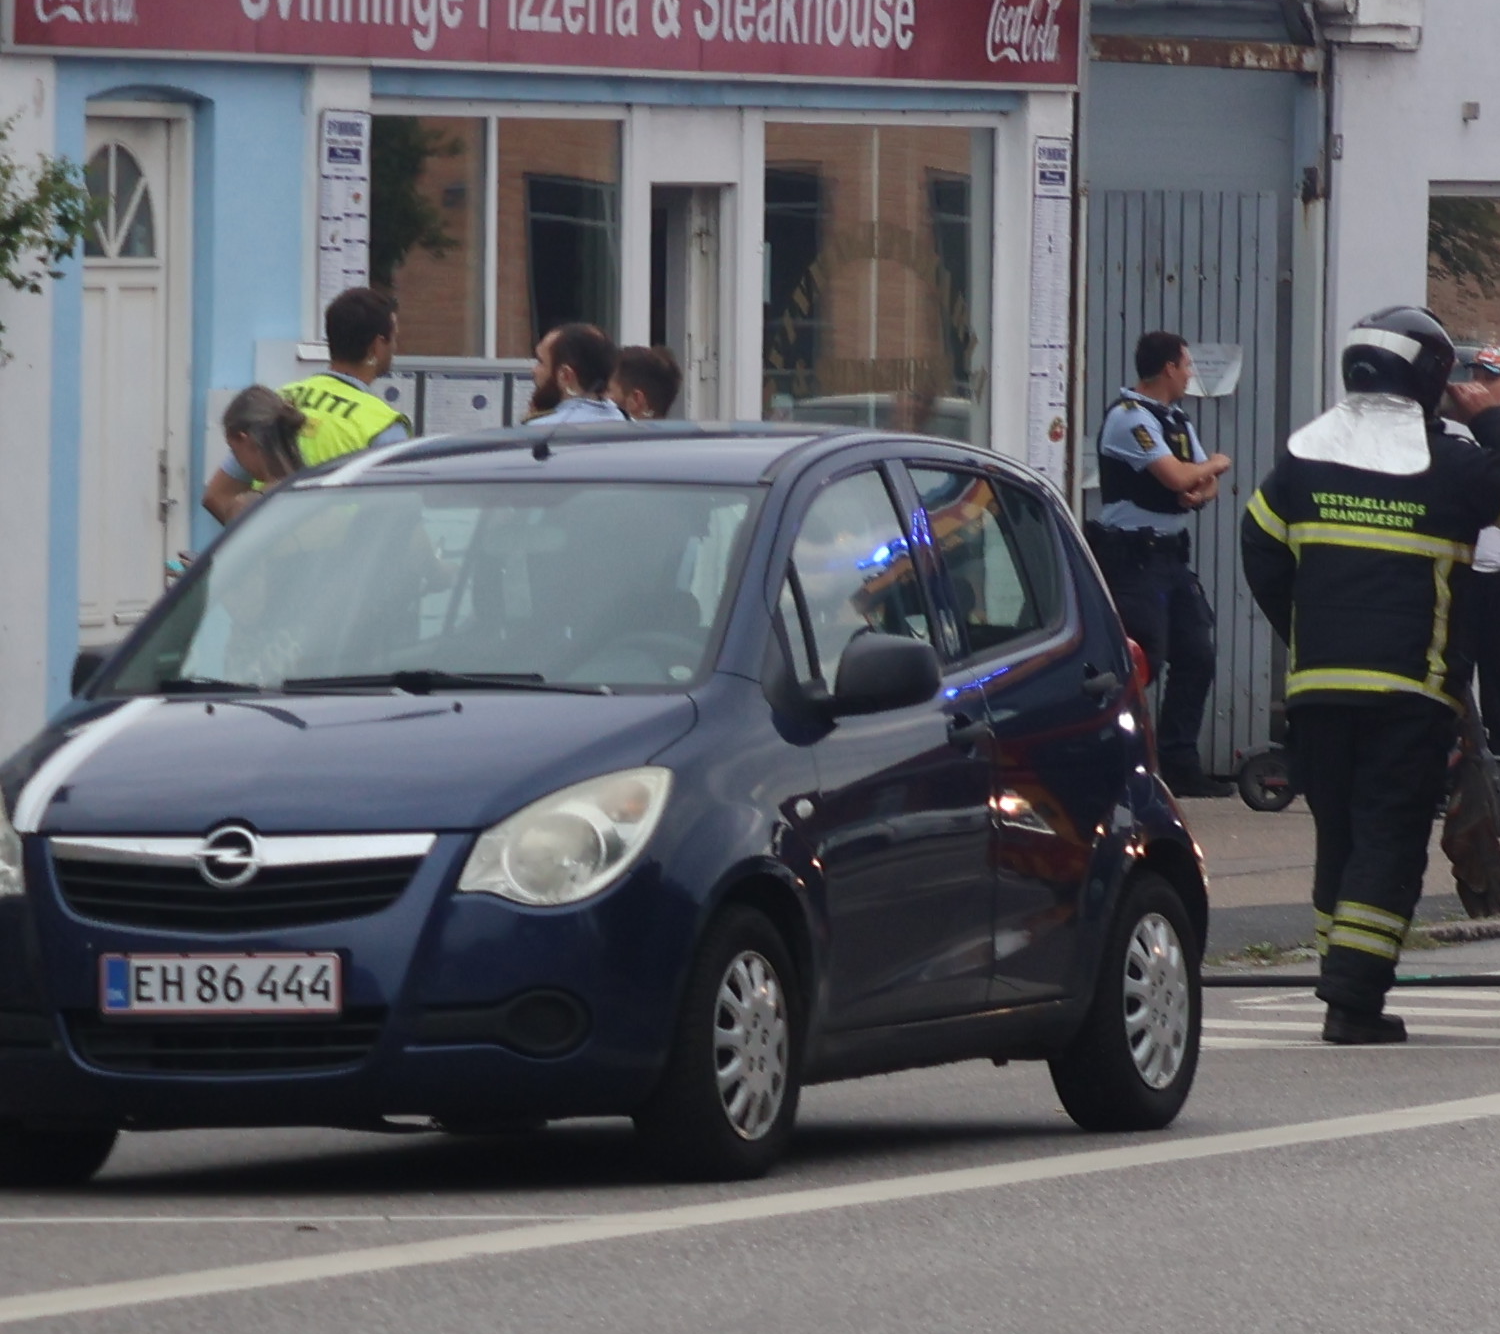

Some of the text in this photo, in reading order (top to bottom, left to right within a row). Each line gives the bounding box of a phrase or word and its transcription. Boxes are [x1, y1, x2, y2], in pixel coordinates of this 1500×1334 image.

[1311, 492, 1426, 515] VESTSJÆLLANDS
[1319, 507, 1413, 528] BRANDVÆSEN
[135, 964, 331, 1004] EH 86 444
